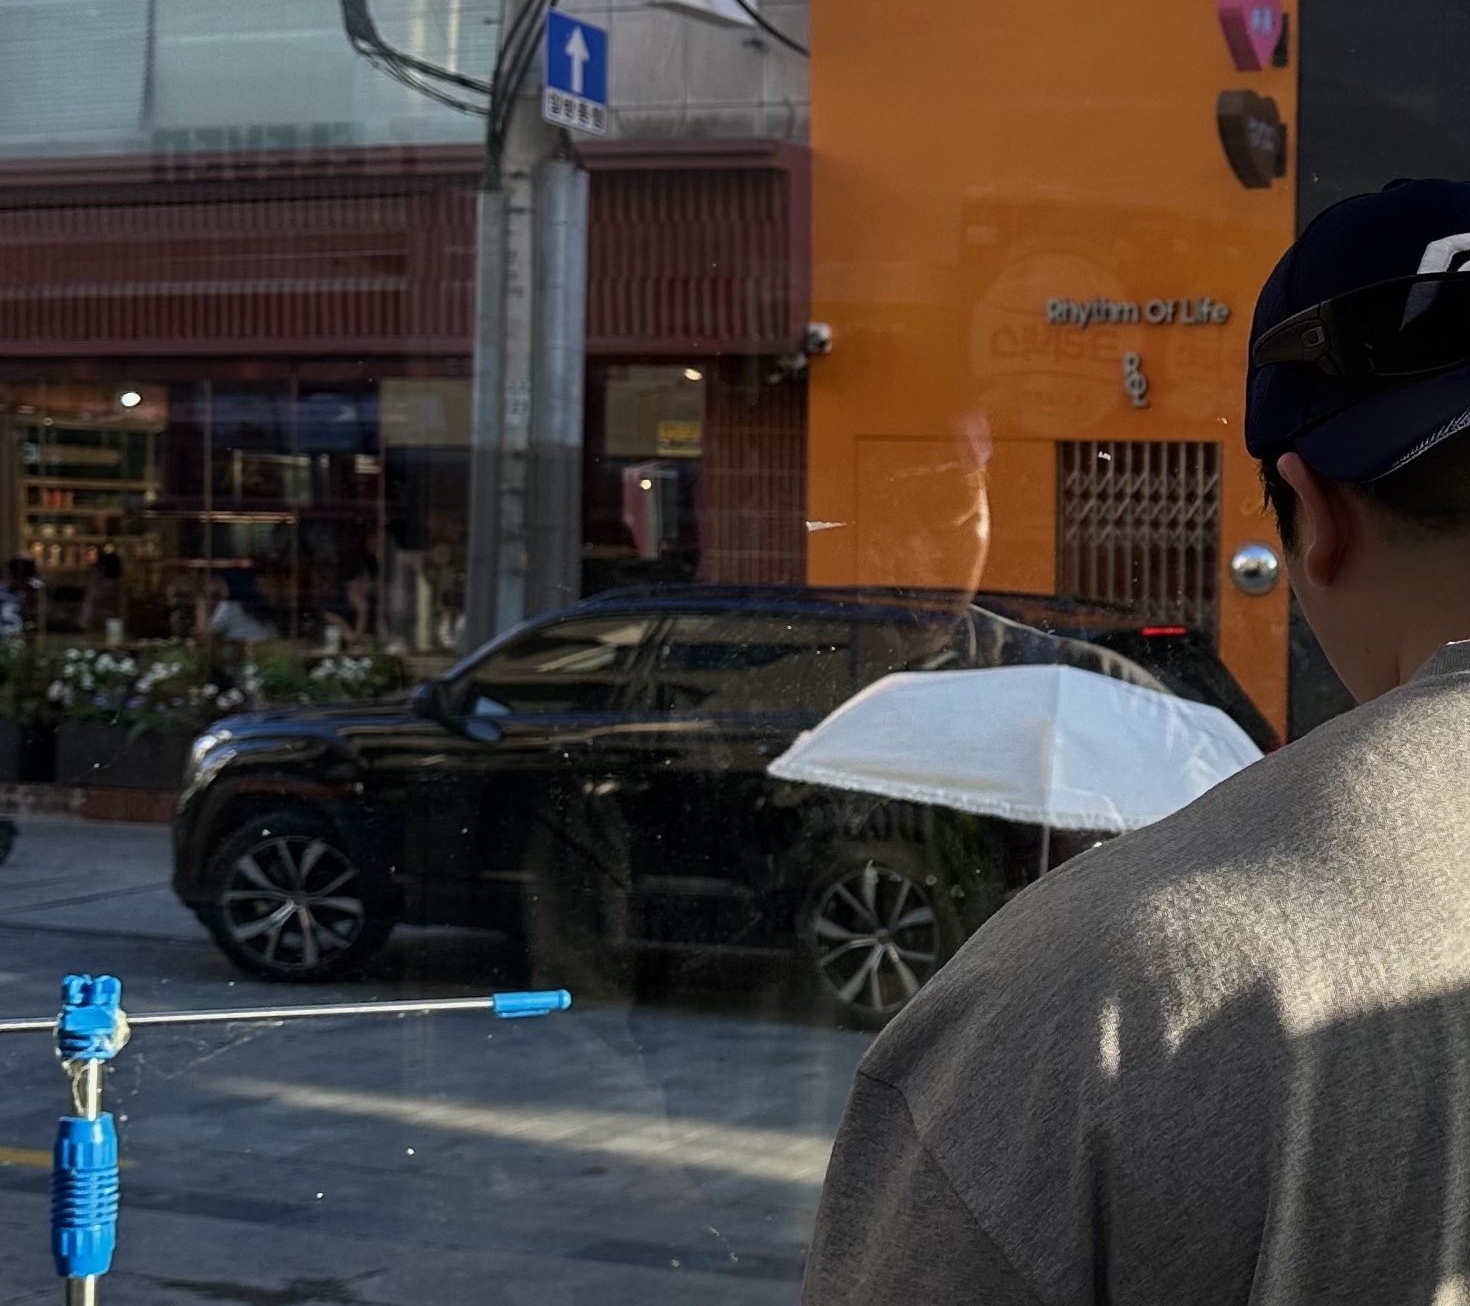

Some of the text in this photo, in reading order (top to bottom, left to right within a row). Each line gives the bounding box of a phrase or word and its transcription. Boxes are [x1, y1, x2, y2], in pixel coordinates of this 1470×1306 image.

[1045, 295, 1232, 327] Rhythm Of Life
